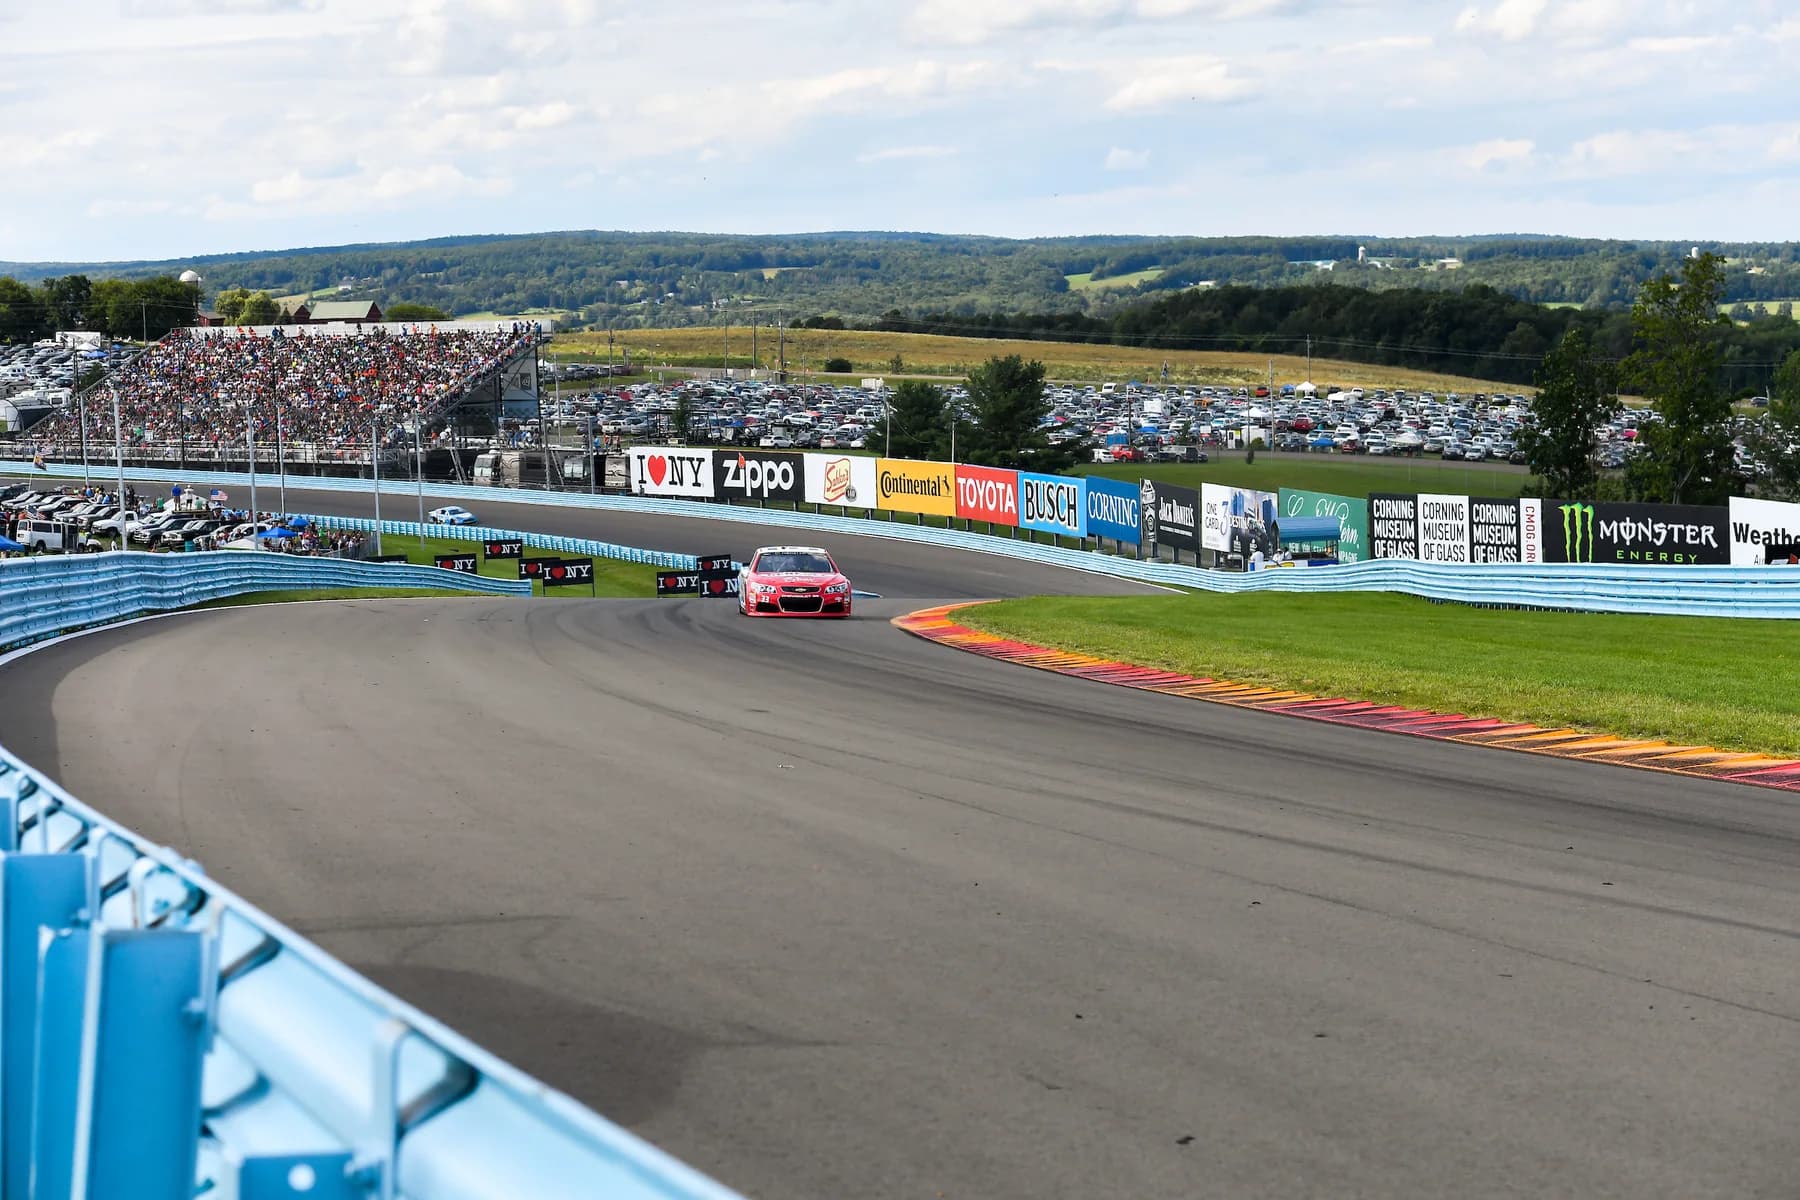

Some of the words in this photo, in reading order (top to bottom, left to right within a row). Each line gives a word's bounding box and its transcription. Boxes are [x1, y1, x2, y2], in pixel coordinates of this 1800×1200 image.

[637, 455, 647, 484] I
[668, 455, 705, 487] NY
[881, 471, 941, 498] Continental
[957, 477, 1016, 514] TOYOTA
[1024, 480, 1078, 528] BUSCH
[1088, 491, 1138, 527] CORNING
[1206, 502, 1217, 515] ONE
[1373, 499, 1414, 519] CORNING
[1423, 502, 1464, 521] CORNING
[1472, 503, 1516, 524] CORNING
[1374, 519, 1415, 539] MUSEUM
[1423, 522, 1464, 542] MUSEUM
[1473, 524, 1517, 545] MUSEUM
[1525, 506, 1536, 563] CMOG.OR
[485, 545, 491, 554] I
[501, 543, 521, 554] NY
[1374, 540, 1386, 558] OF
[1387, 541, 1415, 559] GLASS
[1424, 542, 1435, 560] OF
[1436, 543, 1465, 562] GLASS
[1474, 545, 1486, 563] OF
[1487, 546, 1517, 563] GLASS
[1616, 550, 1697, 564] ENERGY
[454, 559, 475, 570] NY
[520, 564, 527, 574] I
[544, 568, 551, 579] I
[565, 565, 591, 578] NY
[698, 562, 703, 570] I
[712, 559, 730, 569] NY
[658, 577, 664, 588] I
[676, 576, 699, 588] NY
[701, 581, 710, 595] I
[725, 578, 738, 593] N
